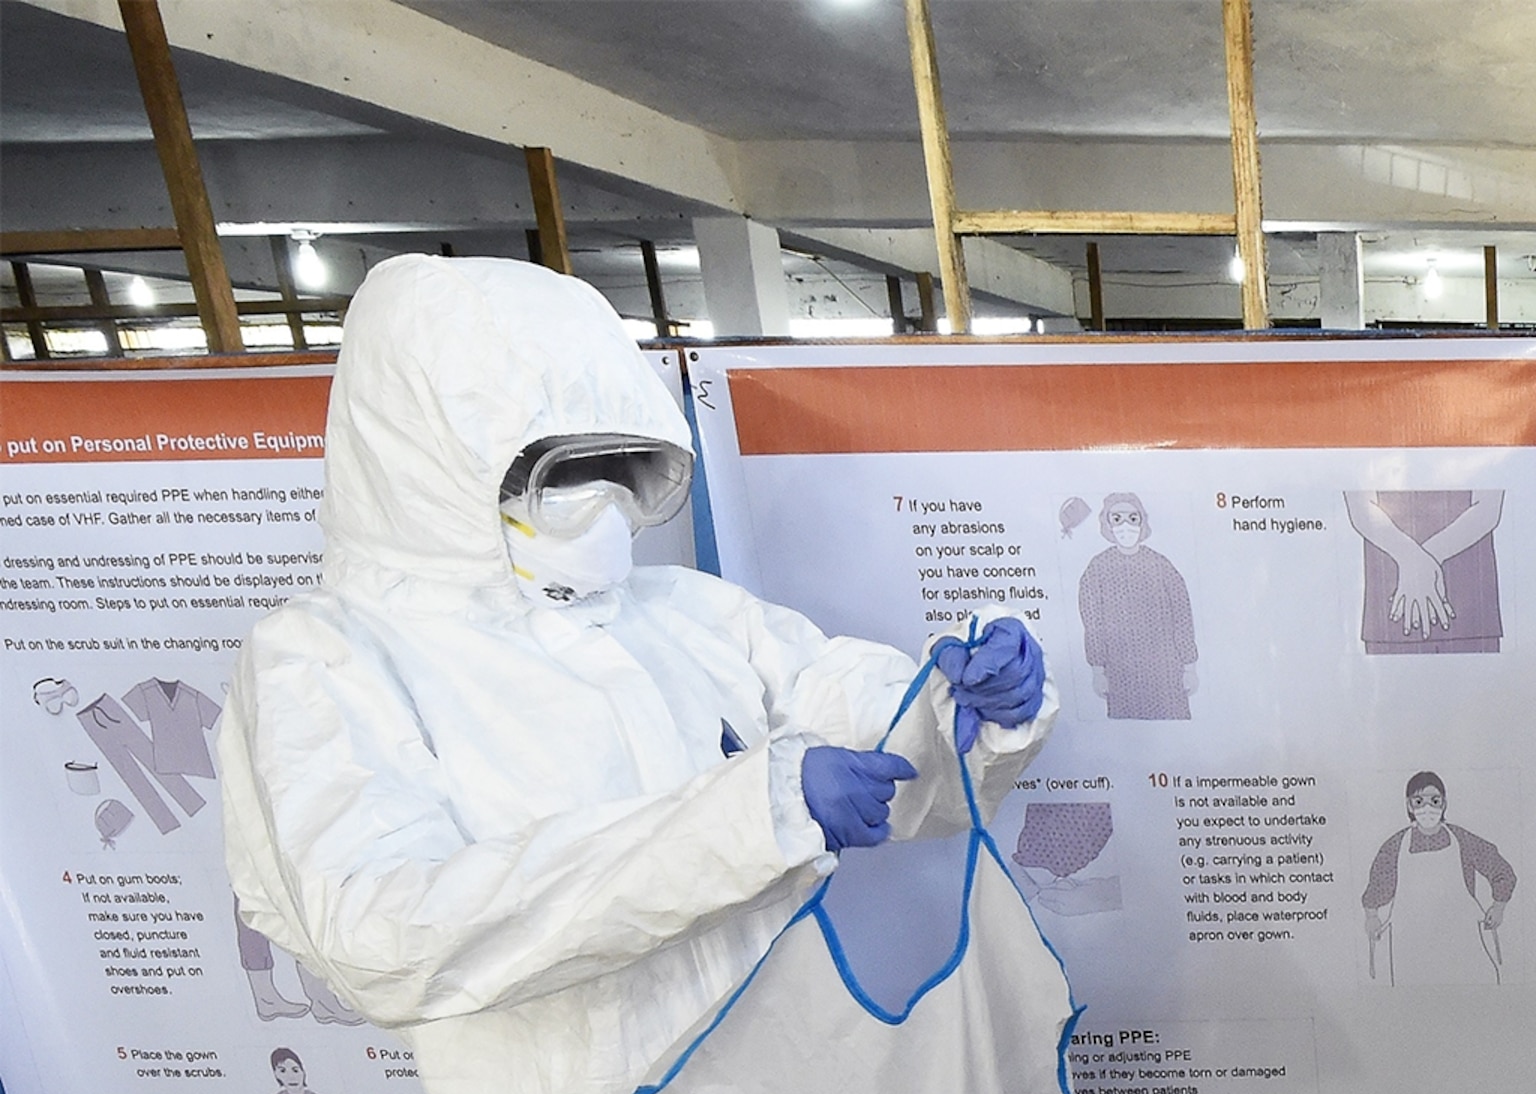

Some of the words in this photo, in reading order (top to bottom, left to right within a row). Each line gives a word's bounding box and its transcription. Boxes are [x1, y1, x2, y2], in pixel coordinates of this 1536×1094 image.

[8, 437, 38, 458] put
[42, 440, 66, 453] on
[70, 434, 152, 452] Personal
[156, 433, 248, 451] Protective
[3, 493, 23, 507] put
[25, 494, 42, 504] on
[45, 490, 103, 504] essential
[106, 490, 158, 506] required
[161, 489, 191, 502] PPE
[193, 489, 228, 501] when
[231, 488, 287, 503] handling
[893, 496, 903, 512] 7
[909, 499, 917, 512] If
[921, 502, 946, 515] you
[949, 499, 982, 512] have
[1216, 492, 1227, 509] 8
[1231, 495, 1285, 509] Perform
[25, 516, 55, 527] case
[58, 512, 71, 526] of
[72, 512, 105, 525] VHF.
[108, 511, 152, 525] Gather
[156, 511, 171, 524] all
[173, 511, 194, 524] the
[197, 512, 262, 525] necessary
[265, 509, 301, 522] items
[304, 508, 316, 522] of
[912, 524, 936, 538] any
[940, 521, 1005, 534] abrasions
[1233, 518, 1267, 531] hand
[1270, 518, 1326, 534] hygiene.
[915, 546, 933, 557] on
[935, 546, 966, 560] your
[969, 543, 1004, 558] scalp
[1008, 545, 1021, 556] or
[3, 555, 55, 571] dressing
[57, 555, 81, 568] and
[82, 554, 151, 570] undressing
[153, 553, 166, 566] of
[168, 553, 198, 566] PPE
[200, 552, 243, 566] should
[246, 552, 263, 565] be
[918, 568, 943, 581] you
[946, 565, 979, 578] have
[983, 567, 1036, 578] concern
[19, 578, 55, 590] team.
[55, 576, 95, 589] These
[96, 575, 167, 588] instructions
[169, 574, 211, 588] should
[213, 574, 231, 587] be
[233, 573, 294, 589] displayed
[297, 575, 314, 586] on
[921, 587, 940, 600] for
[943, 586, 1006, 603] splashing
[1009, 586, 1048, 600] fluids,
[925, 609, 953, 622] also
[4, 638, 26, 651] Put
[28, 641, 44, 650] on
[45, 638, 65, 650] the
[67, 638, 100, 650] scrub
[103, 637, 125, 650] suit
[126, 638, 138, 649] in
[140, 637, 161, 650] the
[163, 637, 219, 652] changing
[1046, 778, 1079, 792] (over
[1082, 776, 1114, 791] cuff).
[1148, 773, 1168, 788] 10
[1173, 776, 1181, 788] If
[1185, 778, 1193, 788] a
[1196, 775, 1278, 790] impermeable
[1281, 777, 1316, 789] gown
[1174, 796, 1185, 808] is
[1189, 796, 1209, 808] not
[1212, 795, 1268, 807] available
[1272, 794, 1296, 806] and
[1176, 818, 1199, 830] you
[1203, 815, 1245, 829] expect
[1248, 815, 1261, 827] to
[1264, 814, 1326, 826] undertake
[1179, 837, 1202, 849] any
[1205, 835, 1266, 846] strenuous
[1270, 833, 1313, 848] activity
[1181, 854, 1209, 869] (e.g.
[1212, 853, 1262, 868] carrying
[1266, 855, 1274, 865] a
[1277, 852, 1324, 867] patient)
[62, 871, 72, 884] 4
[76, 873, 97, 885] Put
[98, 876, 114, 885] on
[116, 875, 144, 887] gum
[145, 873, 182, 885] boots;
[1182, 874, 1196, 885] or
[1198, 873, 1232, 884] tasks
[1234, 872, 1247, 884] in
[1249, 872, 1286, 884] which
[1288, 872, 1334, 883] contact
[81, 892, 90, 903] If
[93, 893, 112, 903] not
[114, 892, 170, 904] available,
[1184, 892, 1210, 903] with
[1213, 891, 1247, 903] blood
[1251, 891, 1274, 903] and
[1277, 890, 1308, 904] body
[1186, 910, 1223, 923] fluids,
[1226, 910, 1259, 924] place
[1262, 908, 1328, 923] waterproof
[1189, 931, 1224, 943] apron
[1226, 931, 1254, 940] over
[1257, 930, 1294, 943] gown.
[110, 984, 172, 995] overshoes.
[1119, 1030, 1160, 1044] PPE:
[117, 1046, 128, 1060] 5
[130, 1049, 163, 1060] Place
[164, 1050, 183, 1061] the
[185, 1051, 218, 1063] gown
[366, 1047, 377, 1060] 6
[379, 1049, 401, 1060] Put
[1092, 1053, 1105, 1063] or
[1108, 1050, 1162, 1064] adjusting
[1165, 1050, 1192, 1061] PPE
[136, 1069, 161, 1077] over
[163, 1067, 182, 1078] the
[184, 1067, 226, 1078] scrubs.
